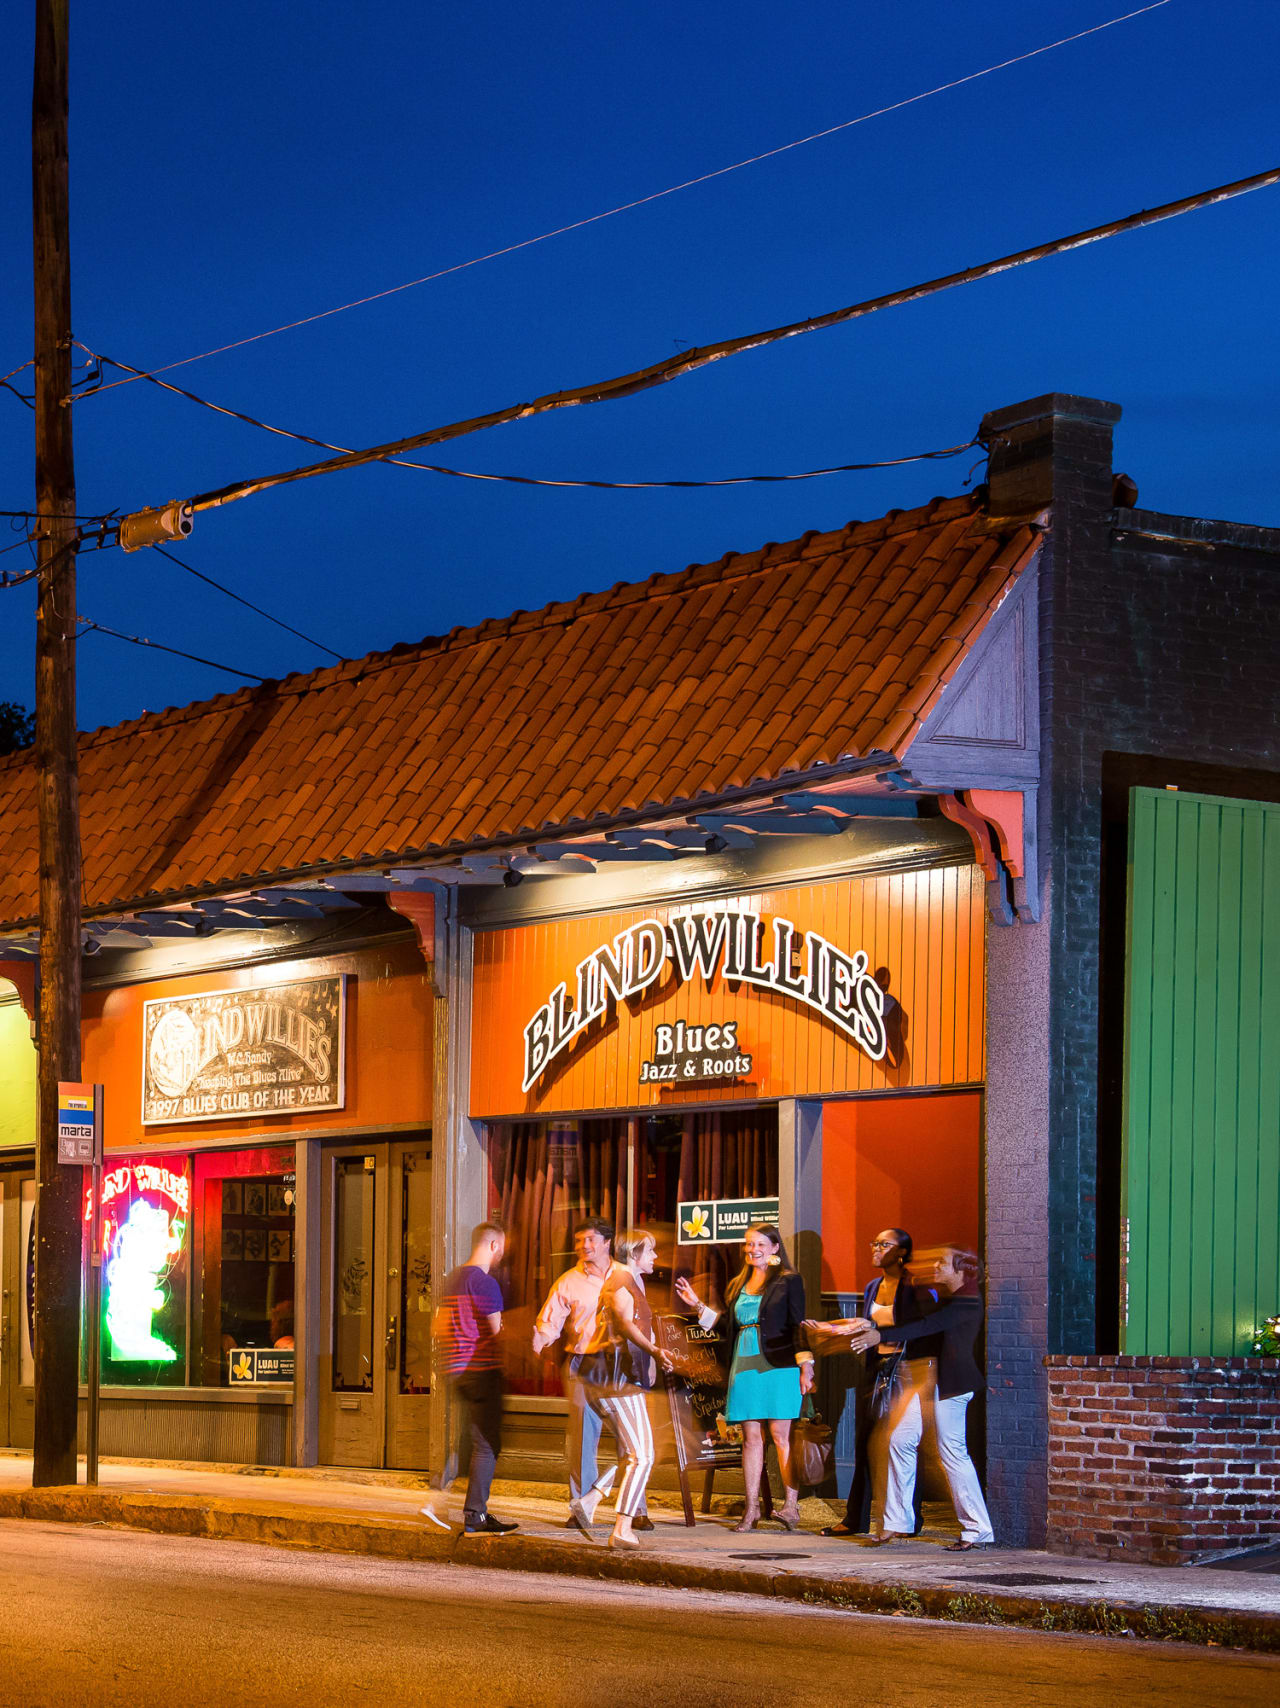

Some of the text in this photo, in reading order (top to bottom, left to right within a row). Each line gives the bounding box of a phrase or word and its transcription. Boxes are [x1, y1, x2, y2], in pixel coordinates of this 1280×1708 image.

[521, 911, 888, 1093] BLIND WILLIE'S
[246, 1001, 331, 1083] WILLIE'S
[656, 1022, 737, 1055] Blues
[253, 1068, 276, 1084] Blues
[641, 1055, 750, 1081] Jazz & Roots
[151, 1086, 330, 1117] 1997 BLUES CLUB OF THE YEAR
[61, 1126, 91, 1137] marta
[718, 1212, 748, 1224] LUAU
[687, 1328, 716, 1339] TUACA
[258, 1359, 279, 1369] LUAU
